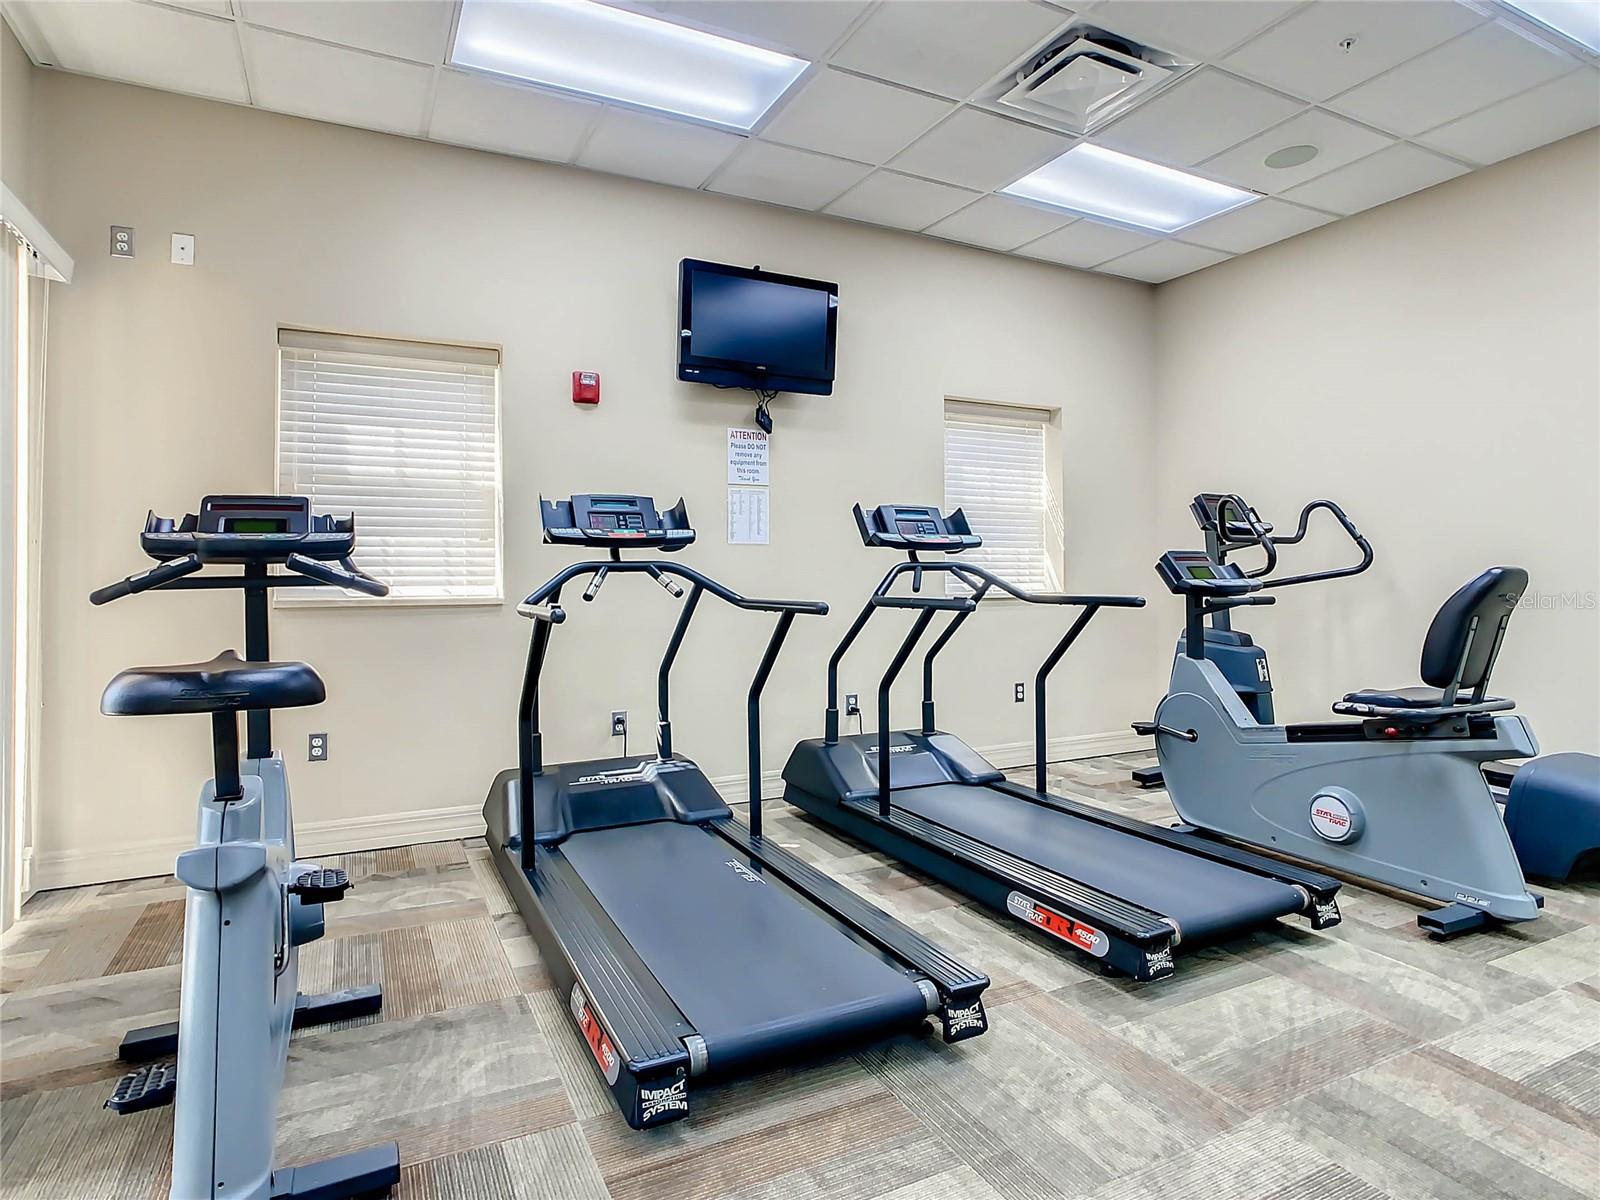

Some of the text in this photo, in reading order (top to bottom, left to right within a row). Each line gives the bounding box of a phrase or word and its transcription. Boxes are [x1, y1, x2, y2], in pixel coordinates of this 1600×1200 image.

[730, 430, 767, 441] ATTENTION
[730, 442, 747, 450] Please
[1013, 896, 1032, 909] STAR
[1074, 928, 1100, 944] 4500
[947, 1001, 980, 1018] IMPACT
[950, 1019, 984, 1036] SYSTEM
[641, 1078, 686, 1100] IMPACT
[643, 1100, 688, 1122] SYSTEM
